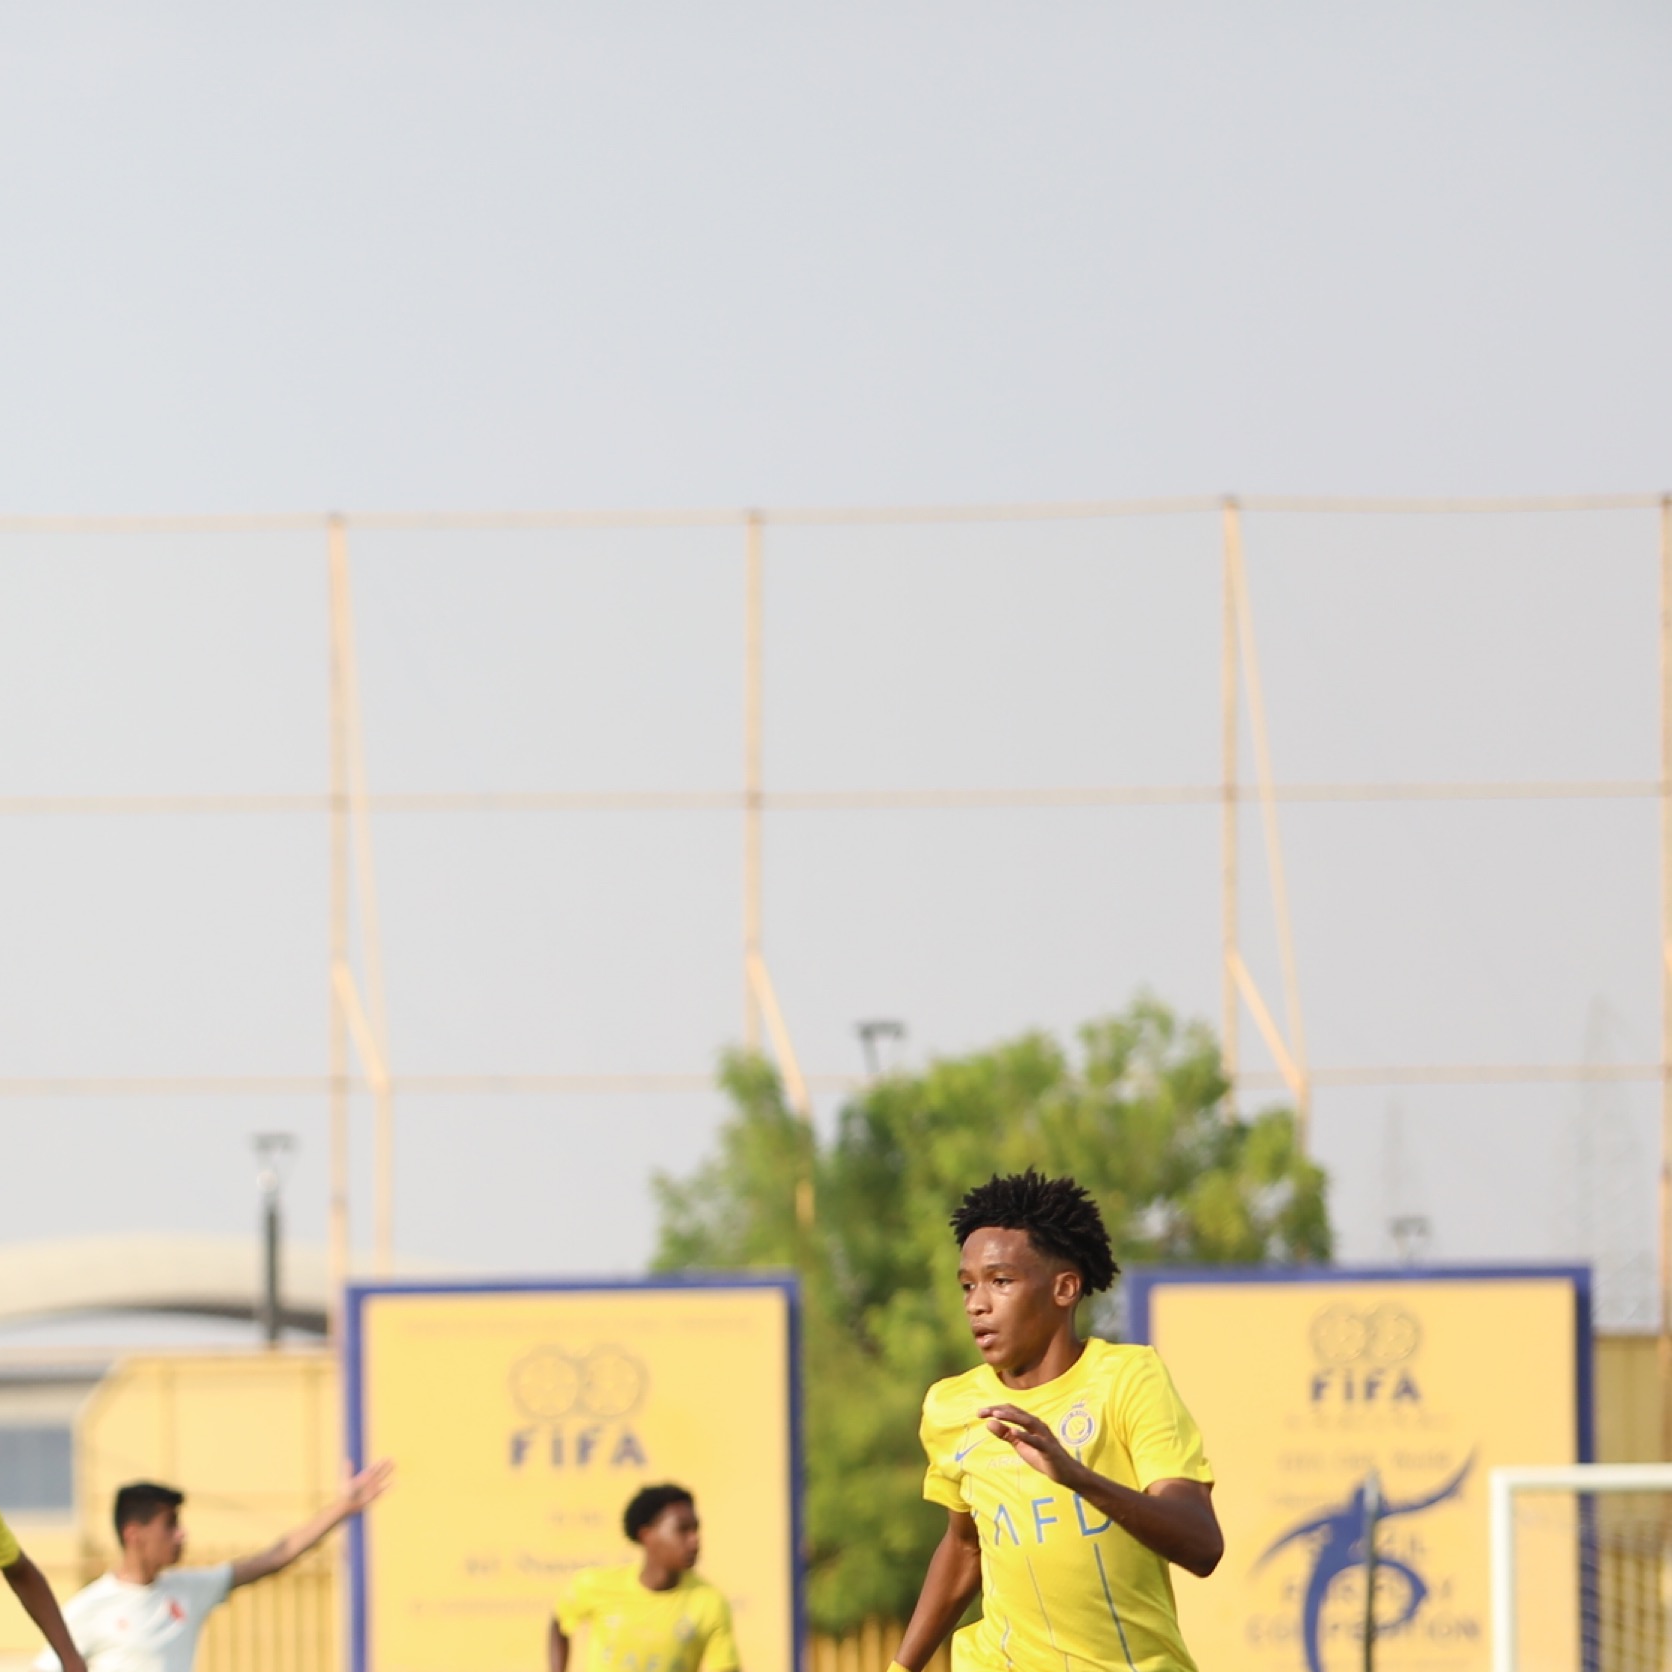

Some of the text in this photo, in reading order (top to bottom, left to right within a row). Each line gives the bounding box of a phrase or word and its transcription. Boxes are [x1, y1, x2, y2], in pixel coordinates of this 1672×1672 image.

[1309, 1367, 1422, 1404] FIFA
[509, 1428, 648, 1468] FIFA
[970, 1493, 1113, 1546] AFD
